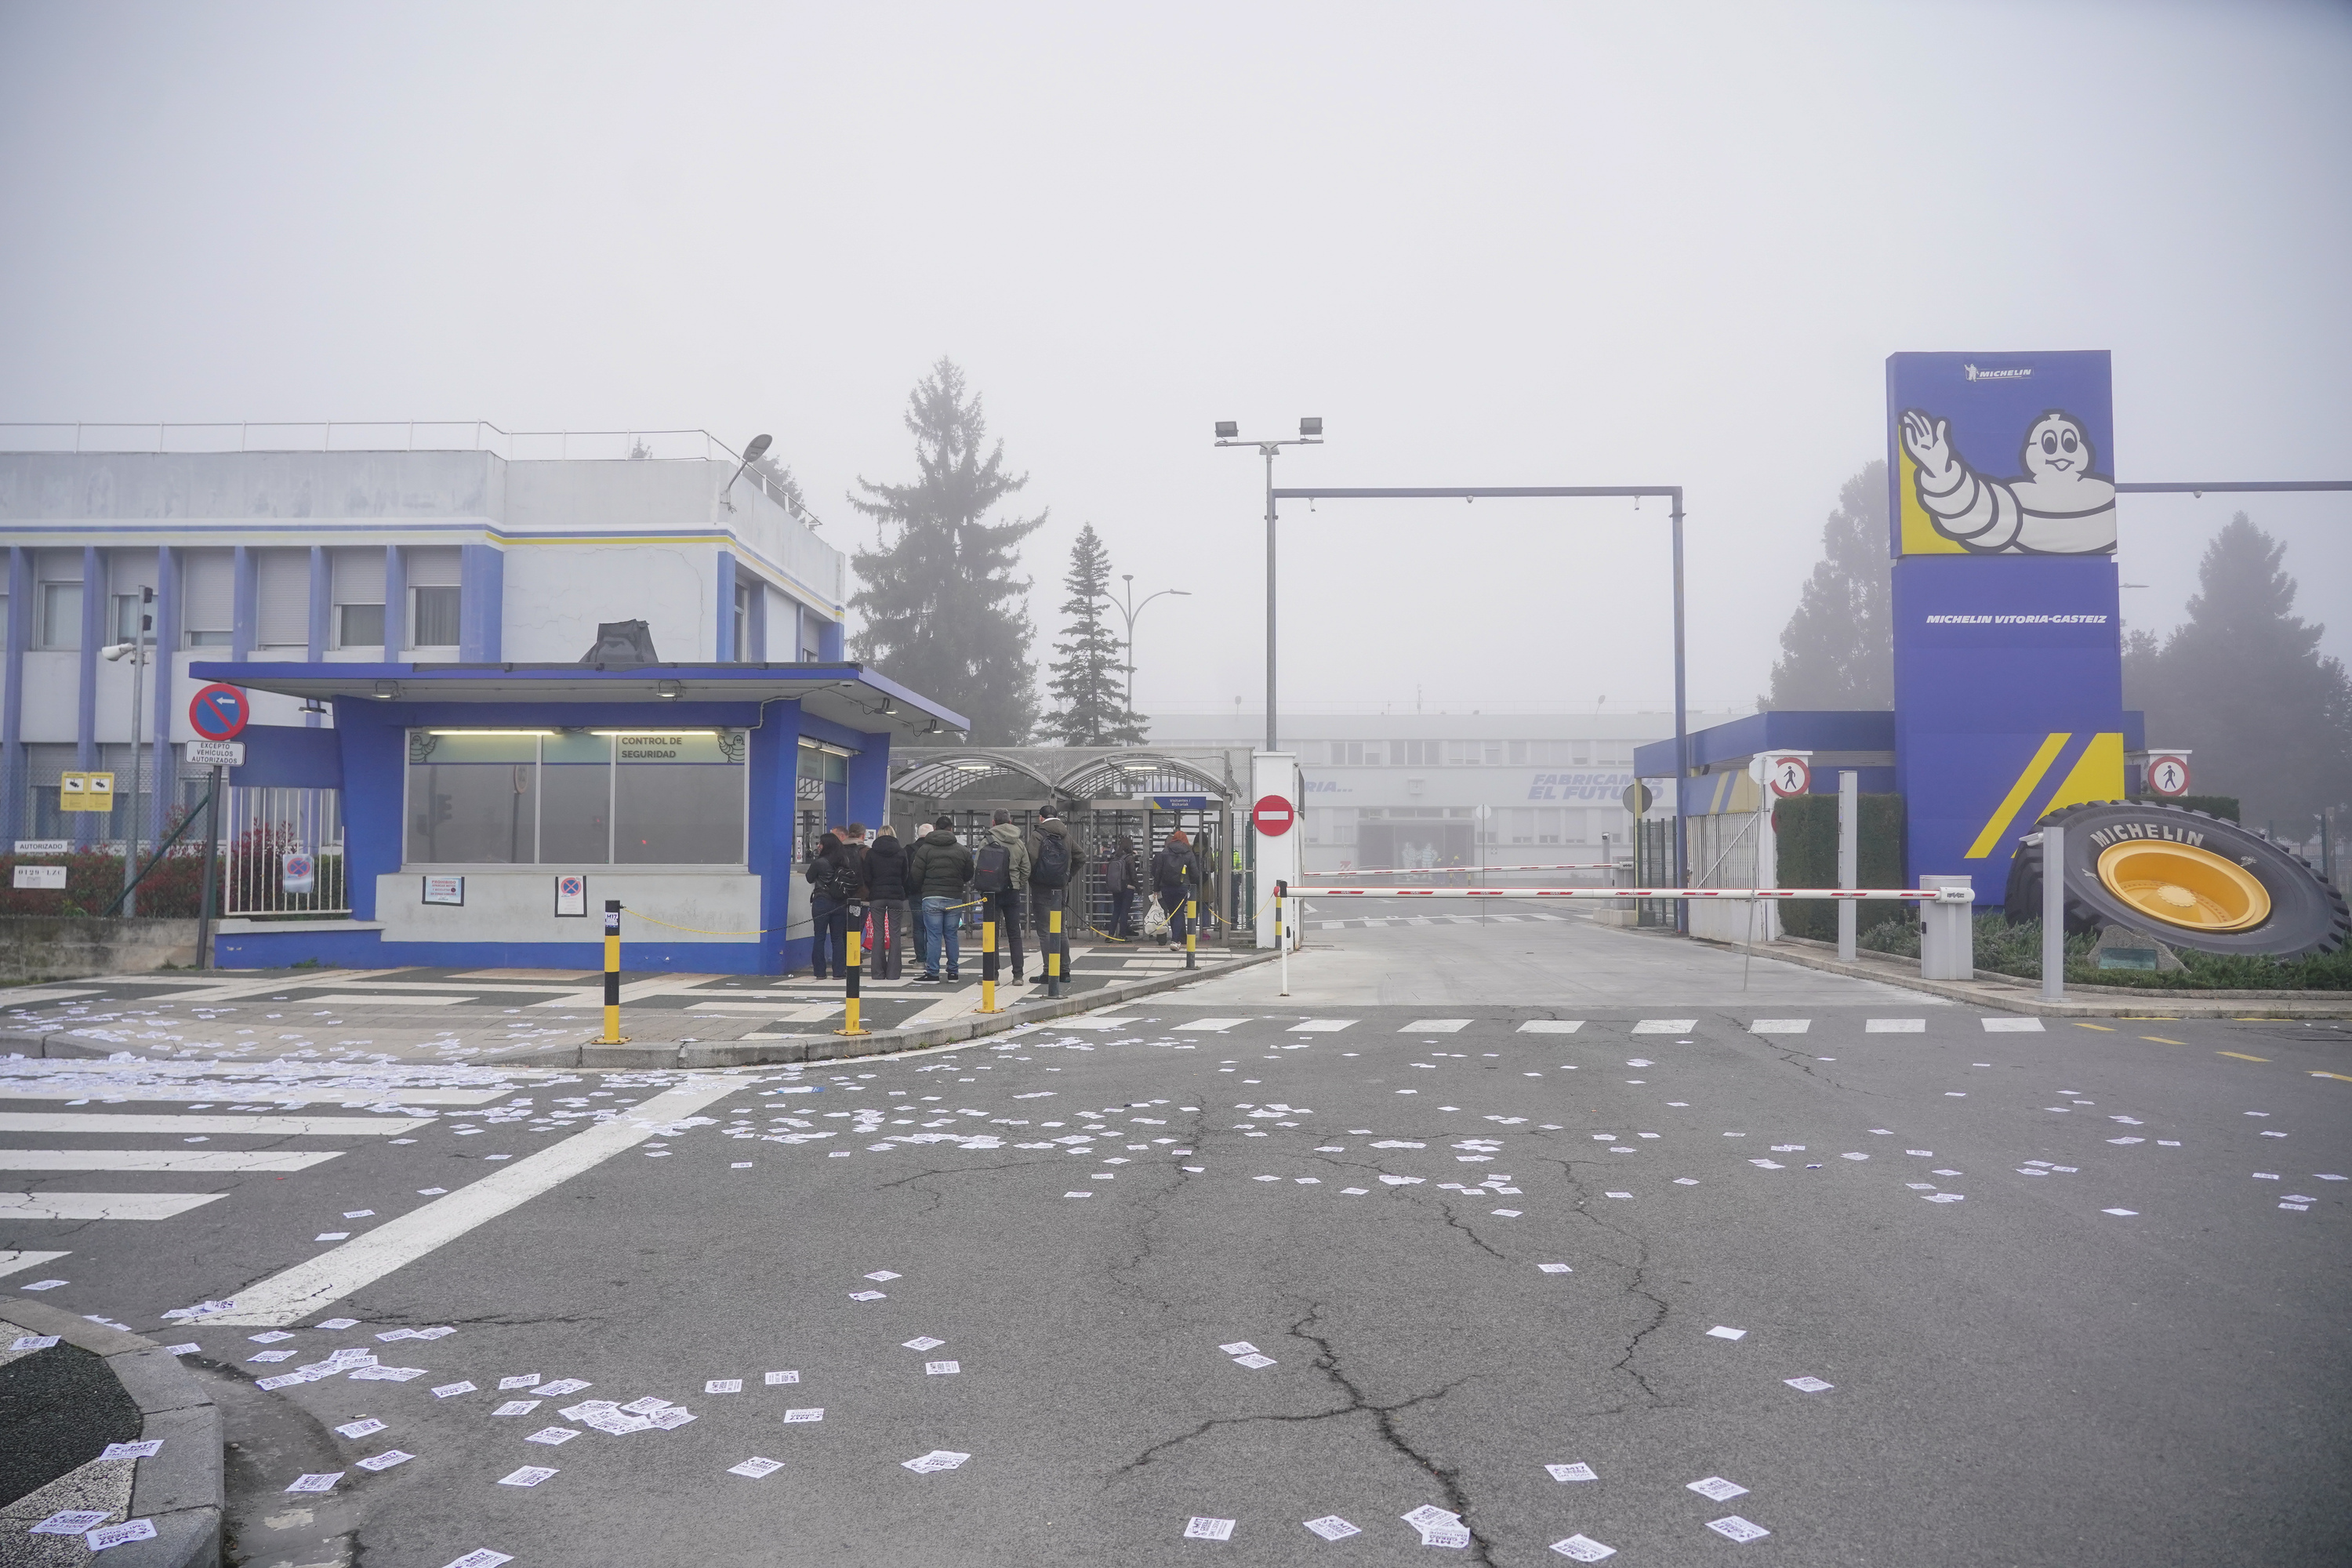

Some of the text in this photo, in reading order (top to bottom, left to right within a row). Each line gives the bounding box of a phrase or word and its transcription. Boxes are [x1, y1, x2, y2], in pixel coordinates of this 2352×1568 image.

[1979, 368, 2031, 377] MICHELIN
[1926, 615, 2107, 624] MICHELIN VITORIA-GASTEIZ
[1527, 786, 1664, 800] EL FUTUO
[2089, 823, 2204, 848] MICHELIN
[99, 1535, 129, 1545] M17
